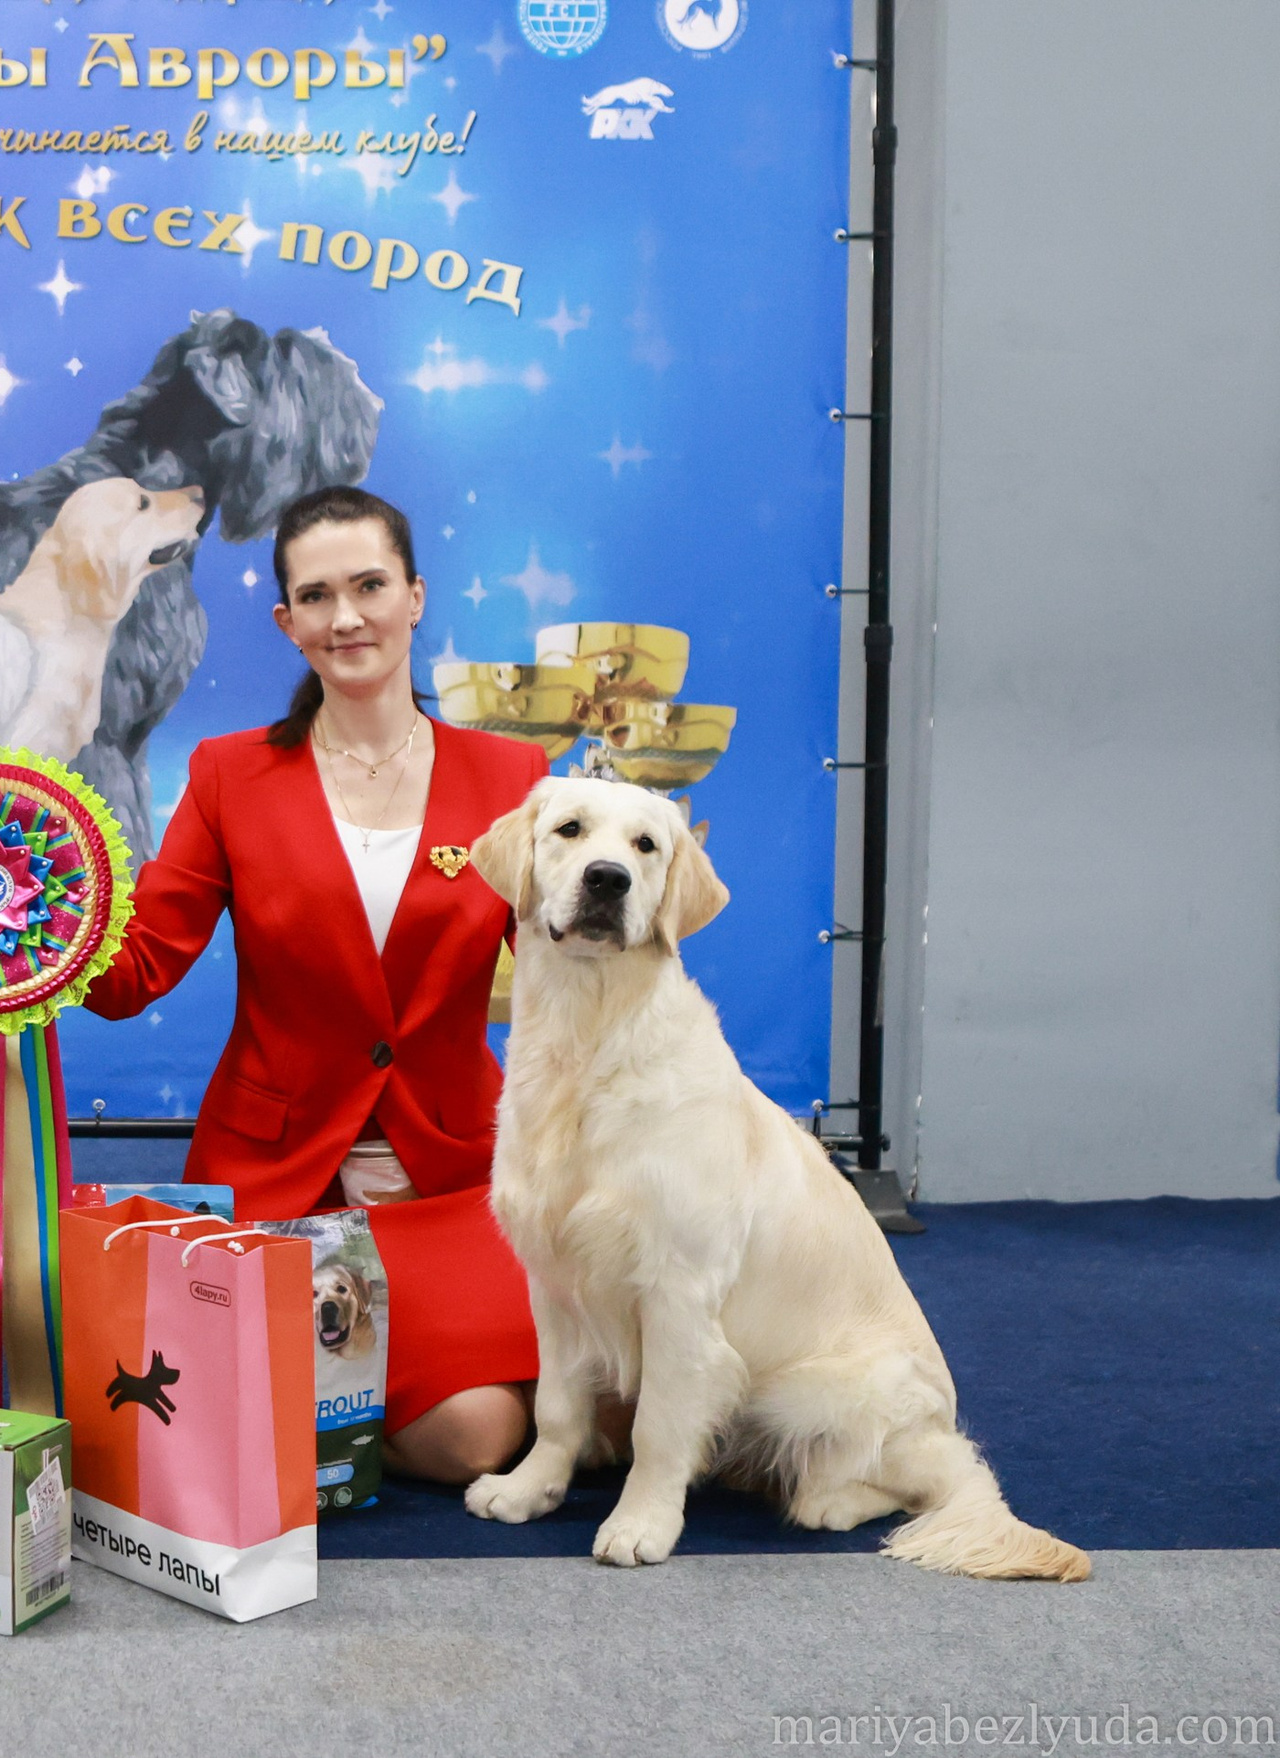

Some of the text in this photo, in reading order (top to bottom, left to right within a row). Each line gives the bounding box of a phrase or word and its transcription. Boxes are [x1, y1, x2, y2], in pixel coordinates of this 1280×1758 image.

[184, 110, 209, 152] в
[214, 129, 345, 160] нашем
[356, 110, 477, 177] клубе!
[56, 198, 246, 253] всех
[278, 219, 524, 314] пород
[194, 1285, 228, 1302] 4lapy.ru
[316, 1389, 375, 1418] ROUT
[326, 1468, 339, 1480] 50
[73, 1512, 152, 1566] четыре
[158, 1551, 221, 1596] лапы
